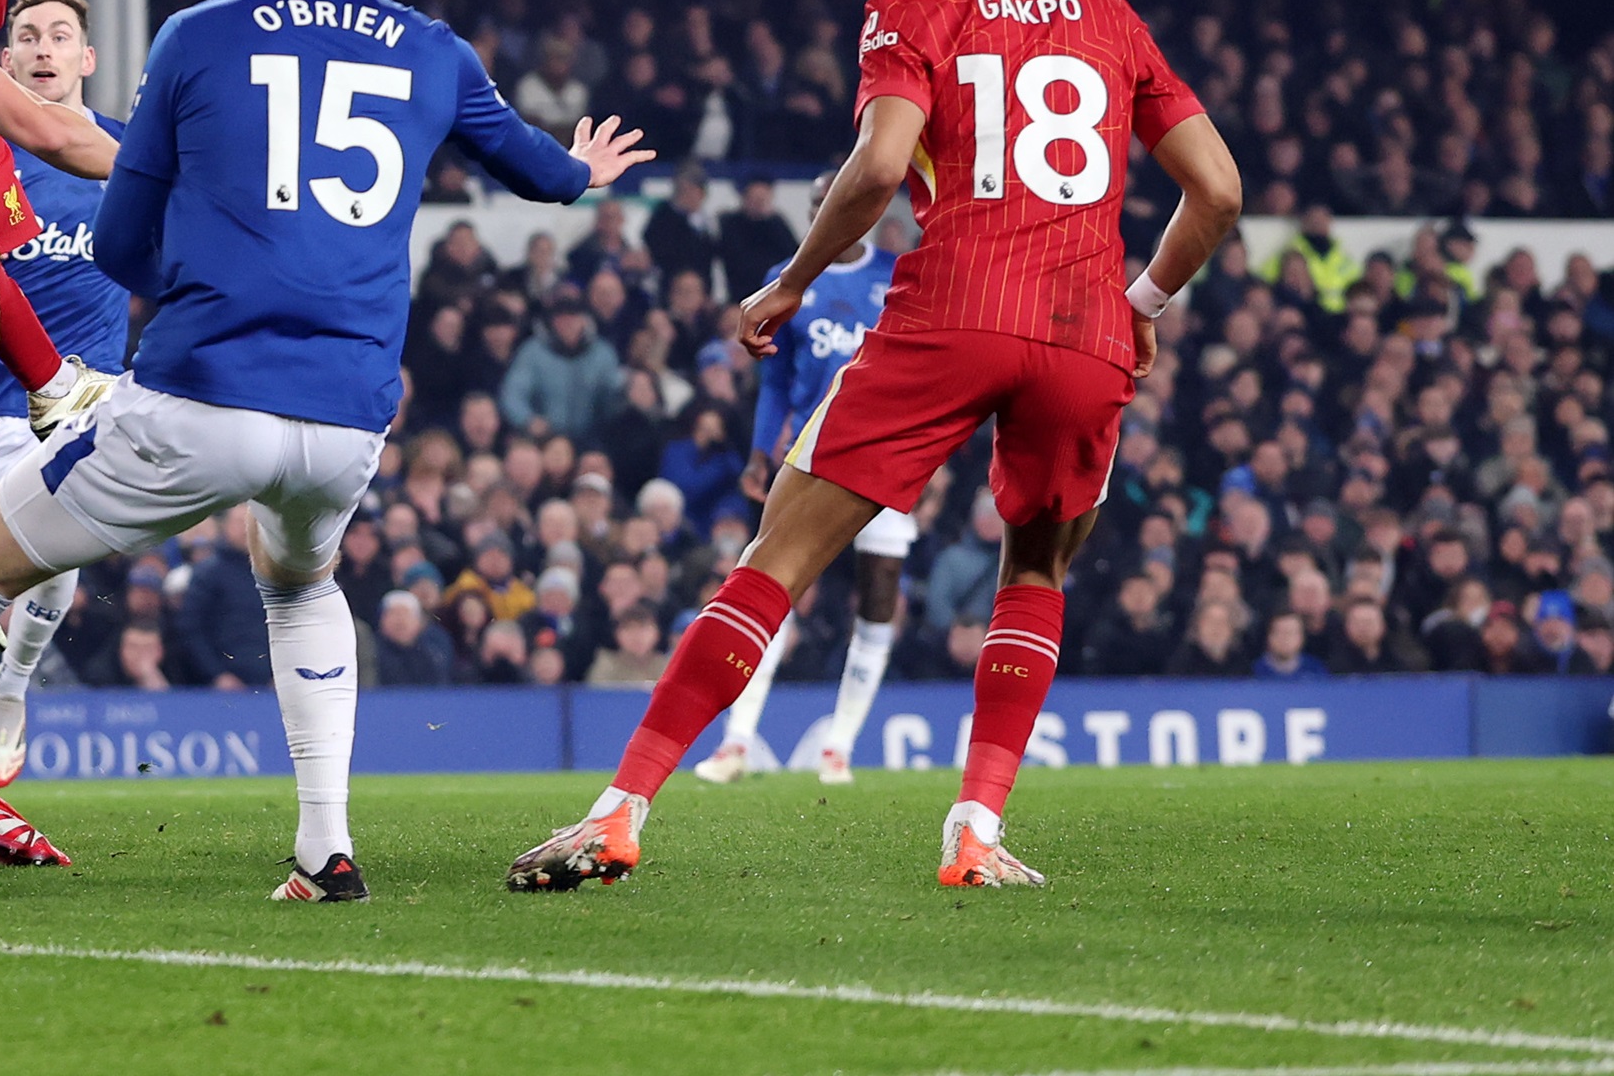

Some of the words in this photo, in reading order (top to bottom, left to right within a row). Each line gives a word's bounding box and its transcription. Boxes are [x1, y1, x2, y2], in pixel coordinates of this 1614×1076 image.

[252, 0, 404, 49] O'BRIEN
[249, 54, 412, 227] 15
[956, 54, 1112, 206] 18
[9, 211, 26, 226] LFC
[12, 216, 94, 261] Stak
[26, 600, 60, 621] EFC
[726, 652, 753, 677] LFC
[991, 663, 1029, 677] LFC
[29, 731, 260, 777] ODISON
[883, 708, 1327, 769] CSTORE
